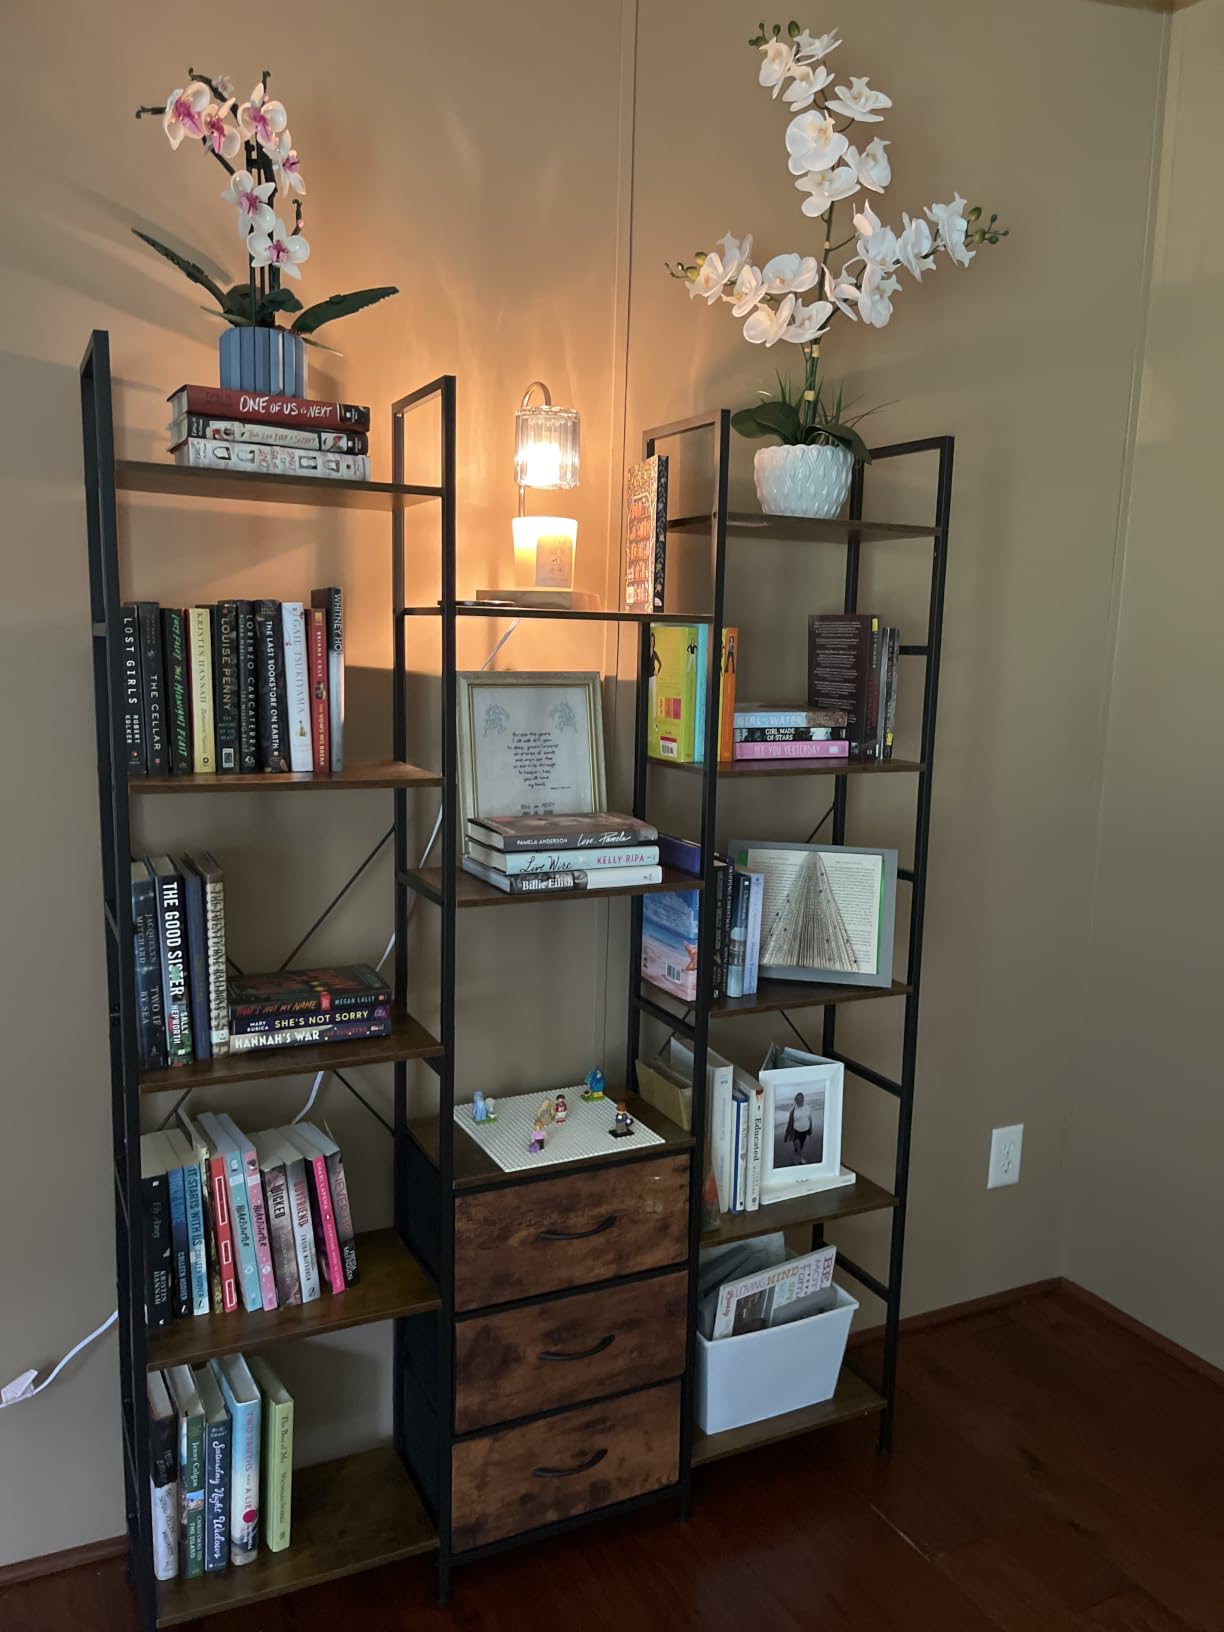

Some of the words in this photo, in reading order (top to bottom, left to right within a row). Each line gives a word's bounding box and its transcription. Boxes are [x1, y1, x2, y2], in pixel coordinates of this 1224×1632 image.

[239, 395, 269, 414] ONE
[269, 402, 281, 414] OF
[283, 402, 298, 415] US
[306, 405, 333, 419] NEXT
[333, 593, 342, 636] WHITNEY
[123, 617, 135, 653] LOST
[196, 612, 206, 656] KRISTIN
[221, 618, 231, 664] LOUISE
[265, 621, 274, 636] THE
[292, 618, 304, 645] GAIL
[246, 614, 256, 670] LORENZO
[267, 637, 275, 657] LAST
[126, 659, 138, 705] GIRLS
[150, 674, 158, 699] THE
[198, 660, 208, 704] HANNAH
[223, 668, 232, 711] PENNY
[267, 660, 278, 707] BOOKSTORE
[293, 651, 306, 714] TSUKIYAMA
[174, 683, 186, 727] MIDNIGHT
[248, 677, 256, 752] CARCATERRA
[270, 709, 278, 721] ON
[125, 714, 133, 744] KOLKER
[132, 714, 141, 744] ROBERT
[151, 703, 161, 751] CELLAR
[271, 724, 280, 749] EARTH
[320, 733, 325, 745] WE
[765, 728, 779, 736] GIRL
[779, 727, 796, 735] MADE
[775, 734, 794, 742] STARS
[177, 728, 188, 757] FEAST
[769, 744, 782, 753] YOU
[784, 743, 821, 753] YESTERDAY
[516, 838, 538, 846] PAMELA
[538, 837, 568, 845] ANDERSON
[598, 831, 632, 844] Pamela
[519, 855, 546, 873] Live
[548, 855, 573, 871] Wire
[596, 854, 624, 866] KELLY
[625, 853, 645, 863] RIPA
[521, 877, 547, 890] Billie
[548, 875, 574, 889] Eilish
[726, 865, 735, 895] SKIPPING
[162, 881, 179, 908] THE
[135, 916, 147, 963] MITCHARD
[145, 913, 158, 963] JACQUELYN
[164, 911, 182, 947] GOOD
[140, 991, 150, 1003] BY
[151, 985, 161, 1012] TWO
[280, 1003, 291, 1012] MY
[292, 1000, 318, 1011] NAME
[334, 997, 356, 1005] MEGAN
[356, 995, 376, 1004] LALLY
[141, 1005, 151, 1024] SEA
[152, 1014, 161, 1026] IF
[171, 1004, 182, 1044] HEPWORTH
[180, 1011, 189, 1034] SALLY
[274, 1018, 305, 1029] SHE'S
[308, 1014, 331, 1025] NOT
[335, 1010, 369, 1022] SORRY
[234, 1031, 292, 1049] HANNAH'S
[294, 1029, 320, 1042] WAR
[246, 1025, 269, 1033] KUBICA
[752, 1117, 763, 1162] Educated
[187, 1167, 198, 1177] IT
[316, 1161, 325, 1182] SHARI
[187, 1178, 200, 1209] STARTS
[270, 1183, 286, 1219] WICKED
[333, 1169, 348, 1212] NEVER
[190, 1211, 202, 1233] WITH
[191, 1234, 203, 1248] US
[300, 1234, 309, 1254] FREIDA
[176, 1250, 187, 1277] COLLEEN
[193, 1249, 203, 1273] COLLEEN
[349, 1249, 357, 1271] FREIDA
[153, 1270, 162, 1305] HANNAH
[159, 1269, 168, 1303] KRISTIN
[178, 1277, 188, 1301] HOOVER
[195, 1275, 206, 1299] HOOVER
[767, 1266, 801, 1287] KIND
[190, 1441, 200, 1461] Jenny
[209, 1440, 226, 1484] Saturday
[190, 1462, 200, 1488] Colgan
[209, 1487, 225, 1513] Night
[244, 1495, 253, 1510] LIE
[189, 1534, 197, 1559] ISLAND
[211, 1515, 227, 1560] Widows
